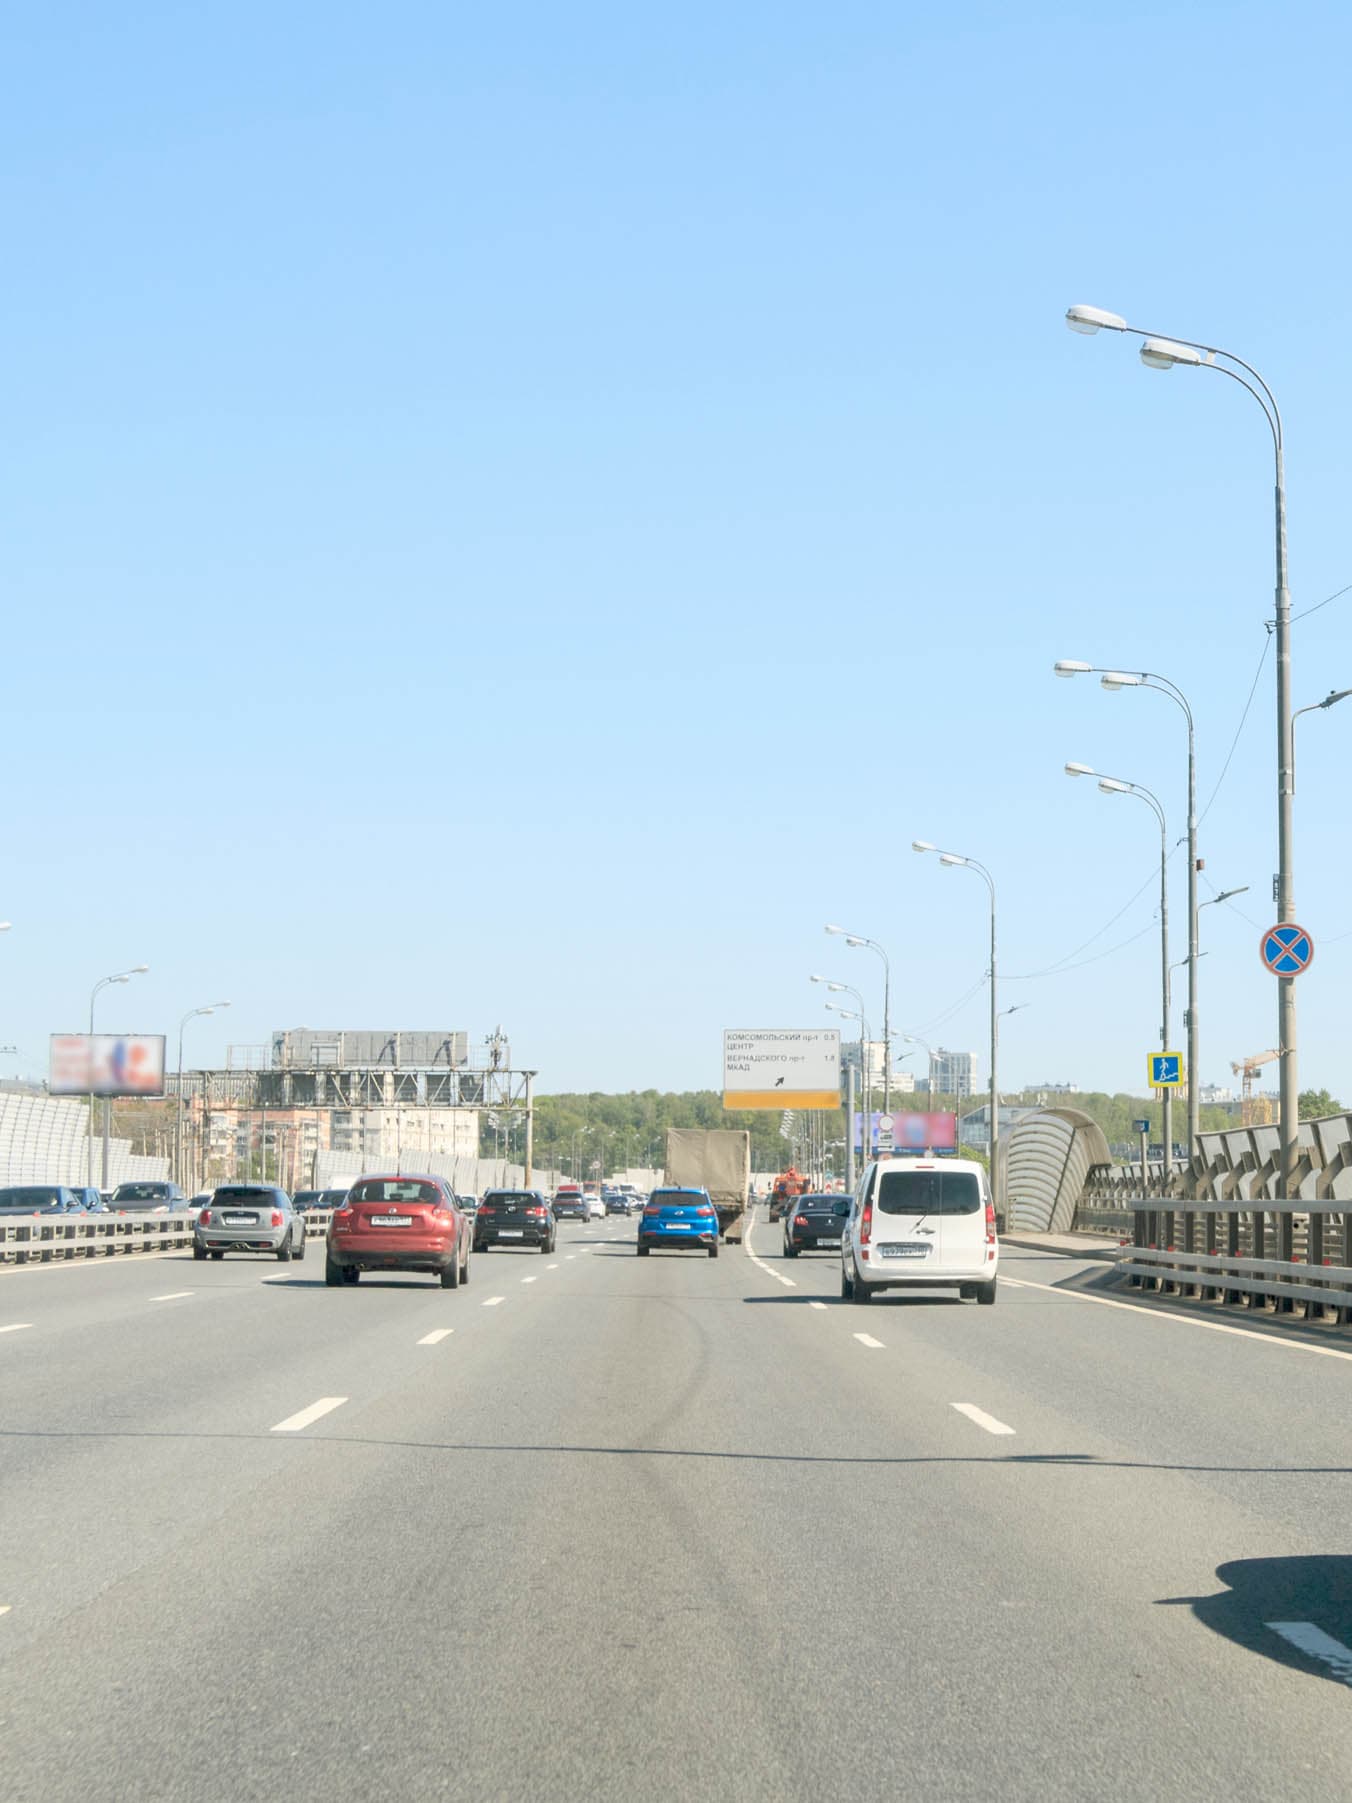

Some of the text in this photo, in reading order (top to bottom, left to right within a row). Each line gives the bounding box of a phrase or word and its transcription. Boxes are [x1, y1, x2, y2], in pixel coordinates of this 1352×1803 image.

[727, 1033, 801, 1041] КОМСОМОЛЬСКИЙ
[727, 1043, 754, 1051] ЦЕНТР
[727, 1054, 787, 1062] ВЕРНАДСКОГО
